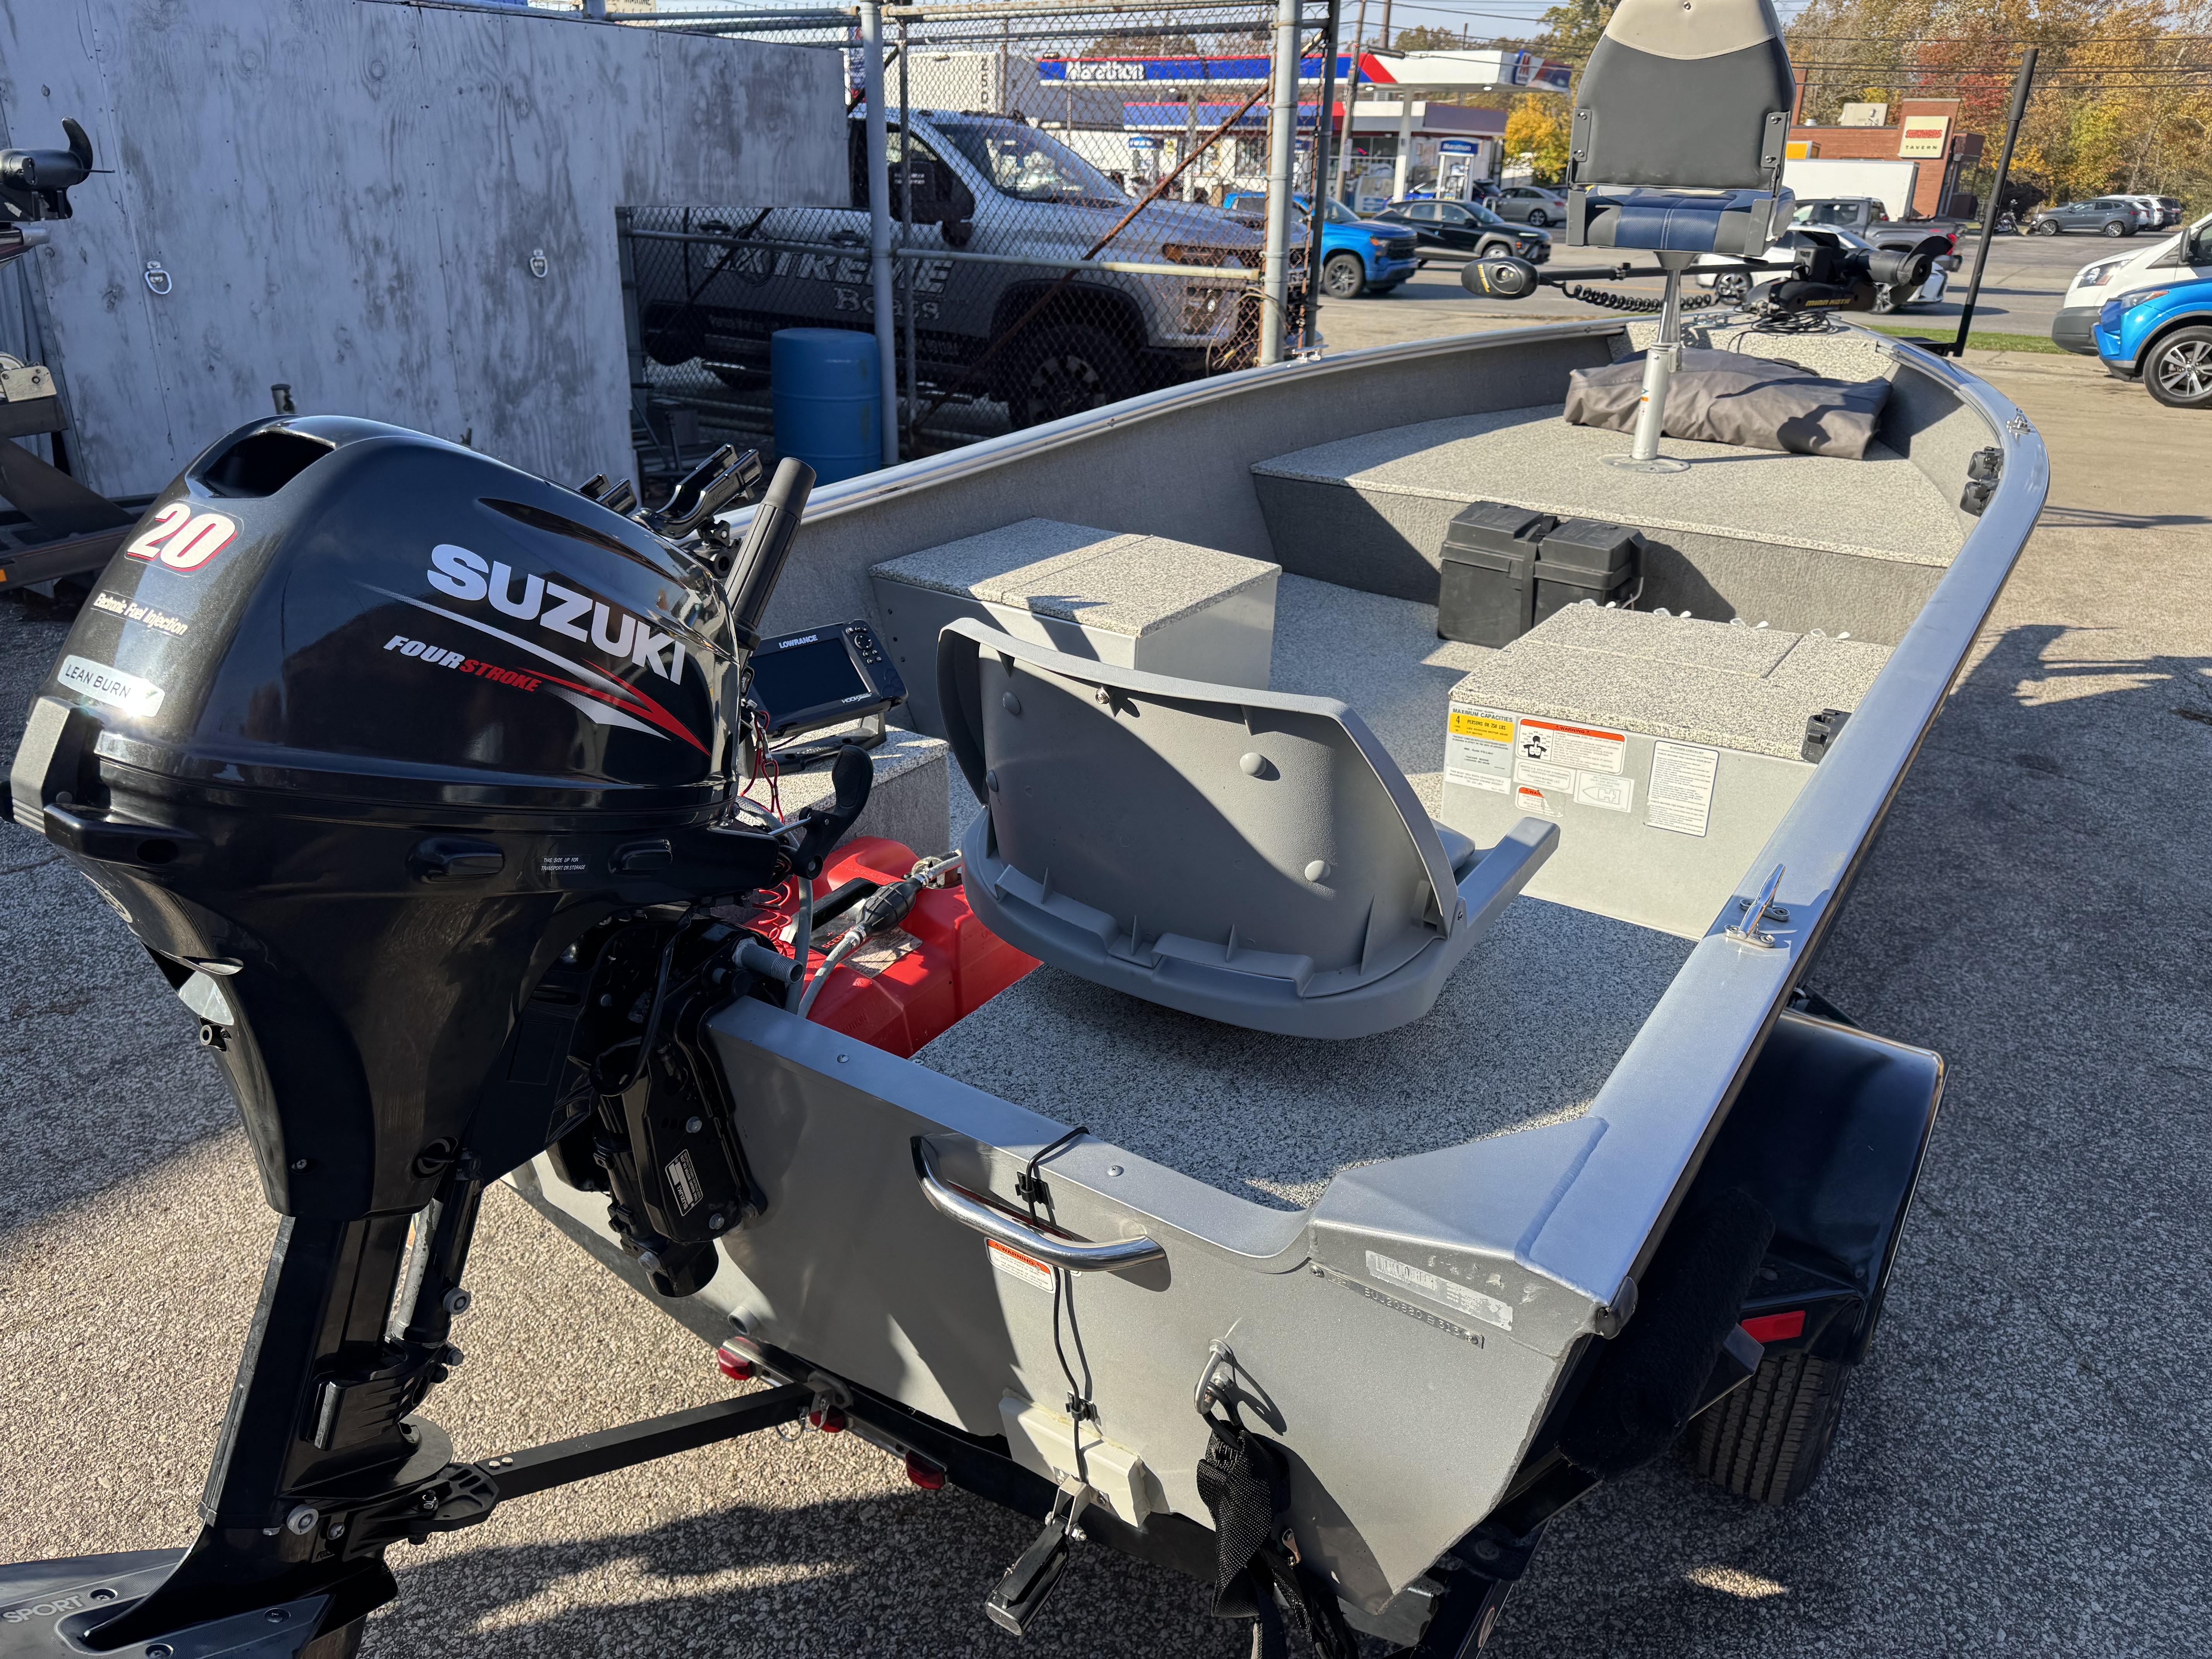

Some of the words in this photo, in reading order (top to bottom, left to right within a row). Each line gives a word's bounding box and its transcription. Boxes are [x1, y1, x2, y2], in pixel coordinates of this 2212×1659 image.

[127, 503, 237, 572] 20
[124, 603, 149, 620] Fuel
[143, 609, 188, 635] Injection
[427, 544, 686, 685] SUZUKI
[778, 635, 818, 649] LOWRANCE
[65, 665, 94, 684] LEAN
[95, 675, 131, 698] BURN
[1453, 708, 1479, 716] MAXIMUM
[1480, 713, 1513, 722] CAPACITIES
[1456, 716, 1460, 724] 4
[677, 1185, 688, 1210] SUZUKI
[1000, 1246, 1035, 1266] WARNING
[2, 1595, 84, 1624] SPORT
